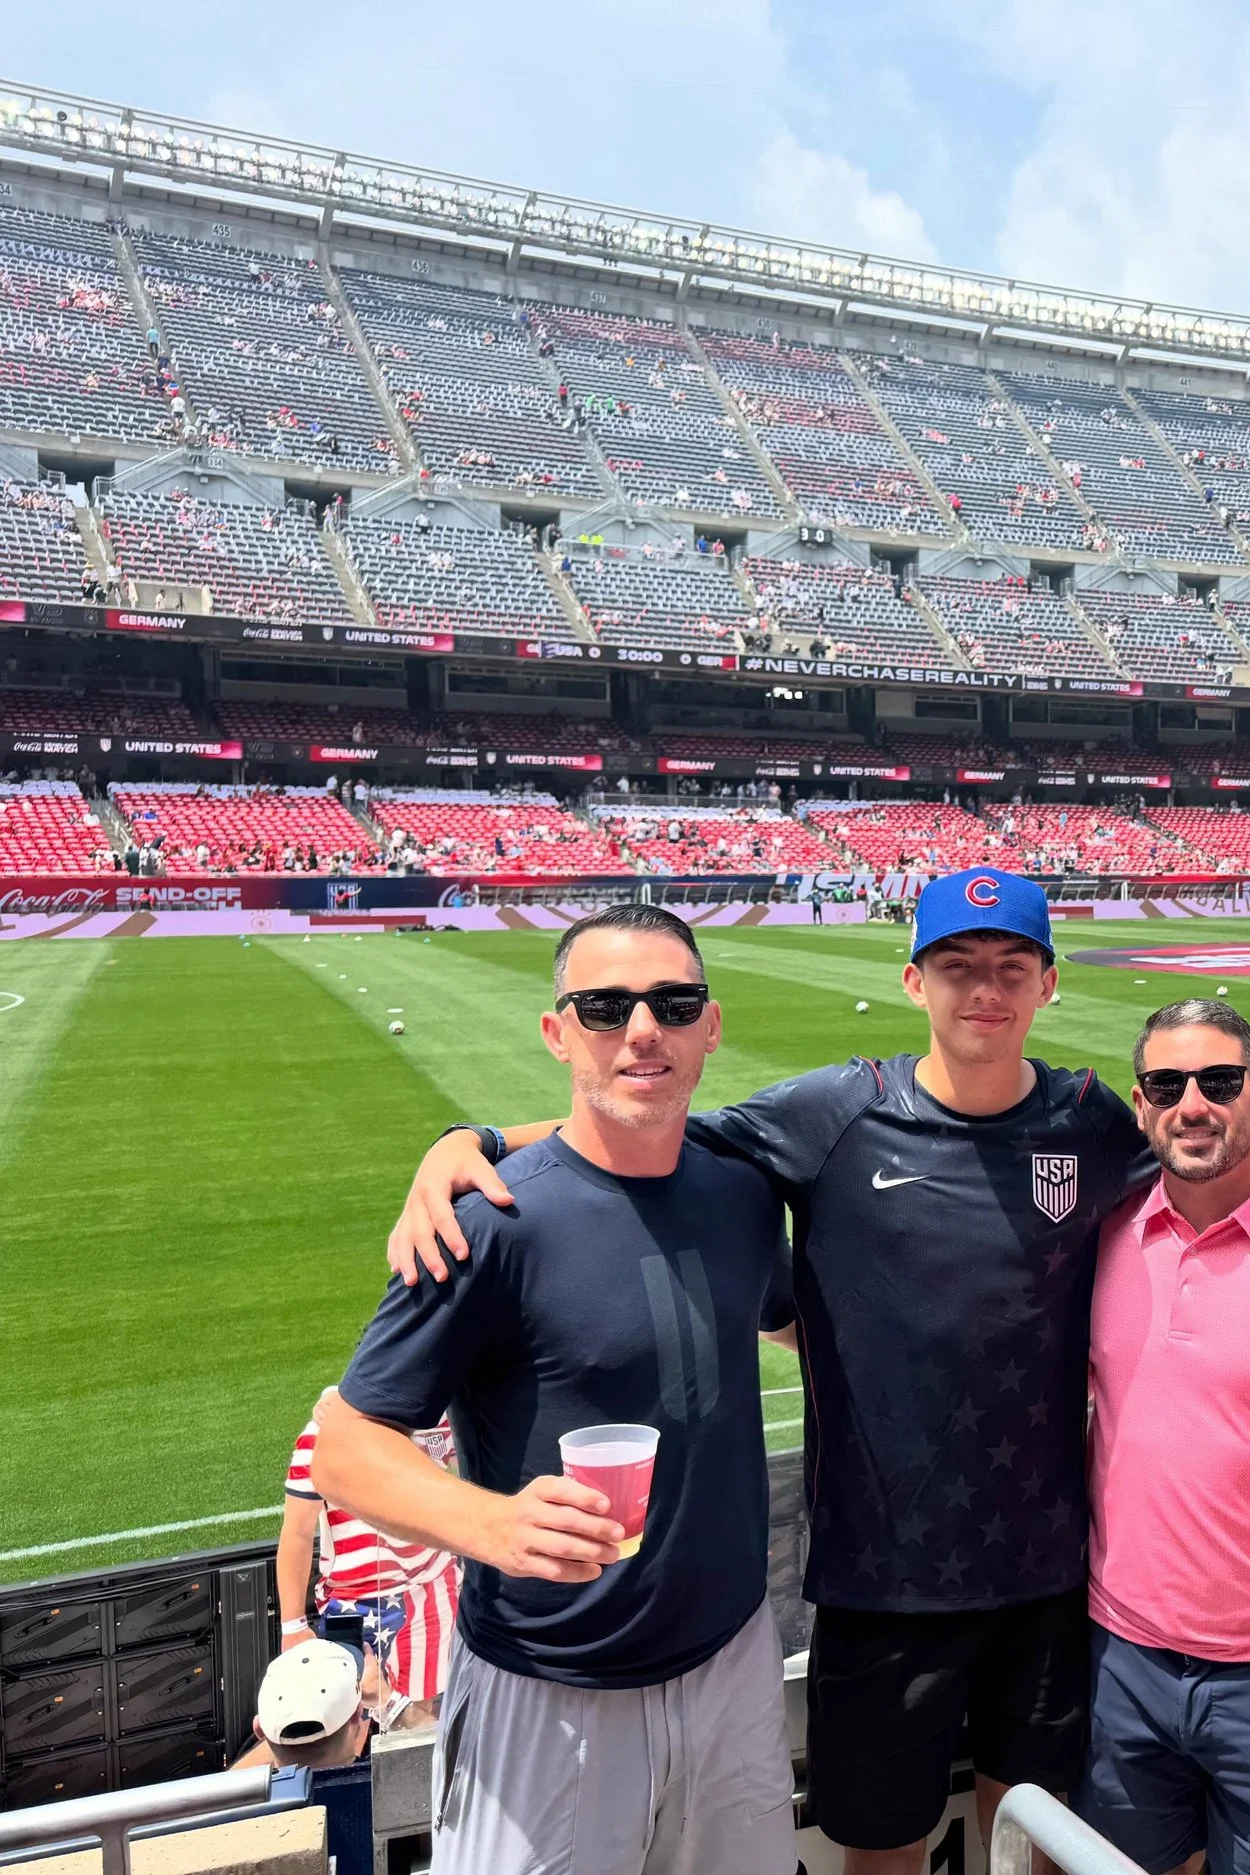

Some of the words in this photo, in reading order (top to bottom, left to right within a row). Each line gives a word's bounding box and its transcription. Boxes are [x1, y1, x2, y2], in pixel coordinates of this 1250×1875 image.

[212, 224, 231, 237] 435
[119, 614, 186, 629] GERMANY
[345, 630, 390, 643] UNITED
[391, 633, 435, 646] STATES
[588, 646, 601, 659] 0
[617, 649, 664, 663] 30:00
[679, 653, 692, 665] 0
[745, 657, 1017, 687] #NEVERCHASEREALITY
[1069, 680, 1100, 691] UNITED
[1101, 682, 1131, 692] STATES
[1193, 687, 1231, 697] GERMANY
[125, 741, 173, 753] UNITED
[175, 742, 222, 755] STATES
[320, 748, 378, 760] GERMANY
[506, 754, 546, 765] UNITED
[547, 755, 586, 766] STATES
[666, 760, 715, 771] GERMANY
[830, 766, 863, 776] UNITED
[864, 767, 896, 777] STATES
[963, 770, 1005, 780] GERMANY
[1101, 776, 1130, 784] UNITED
[1131, 776, 1159, 785] STATES
[116, 887, 241, 901] SEND-OFF
[964, 877, 1001, 907] C
[0, 888, 111, 912] Coca-Cola
[1036, 1159, 1074, 1183] USA
[426, 1436, 443, 1446] USA
